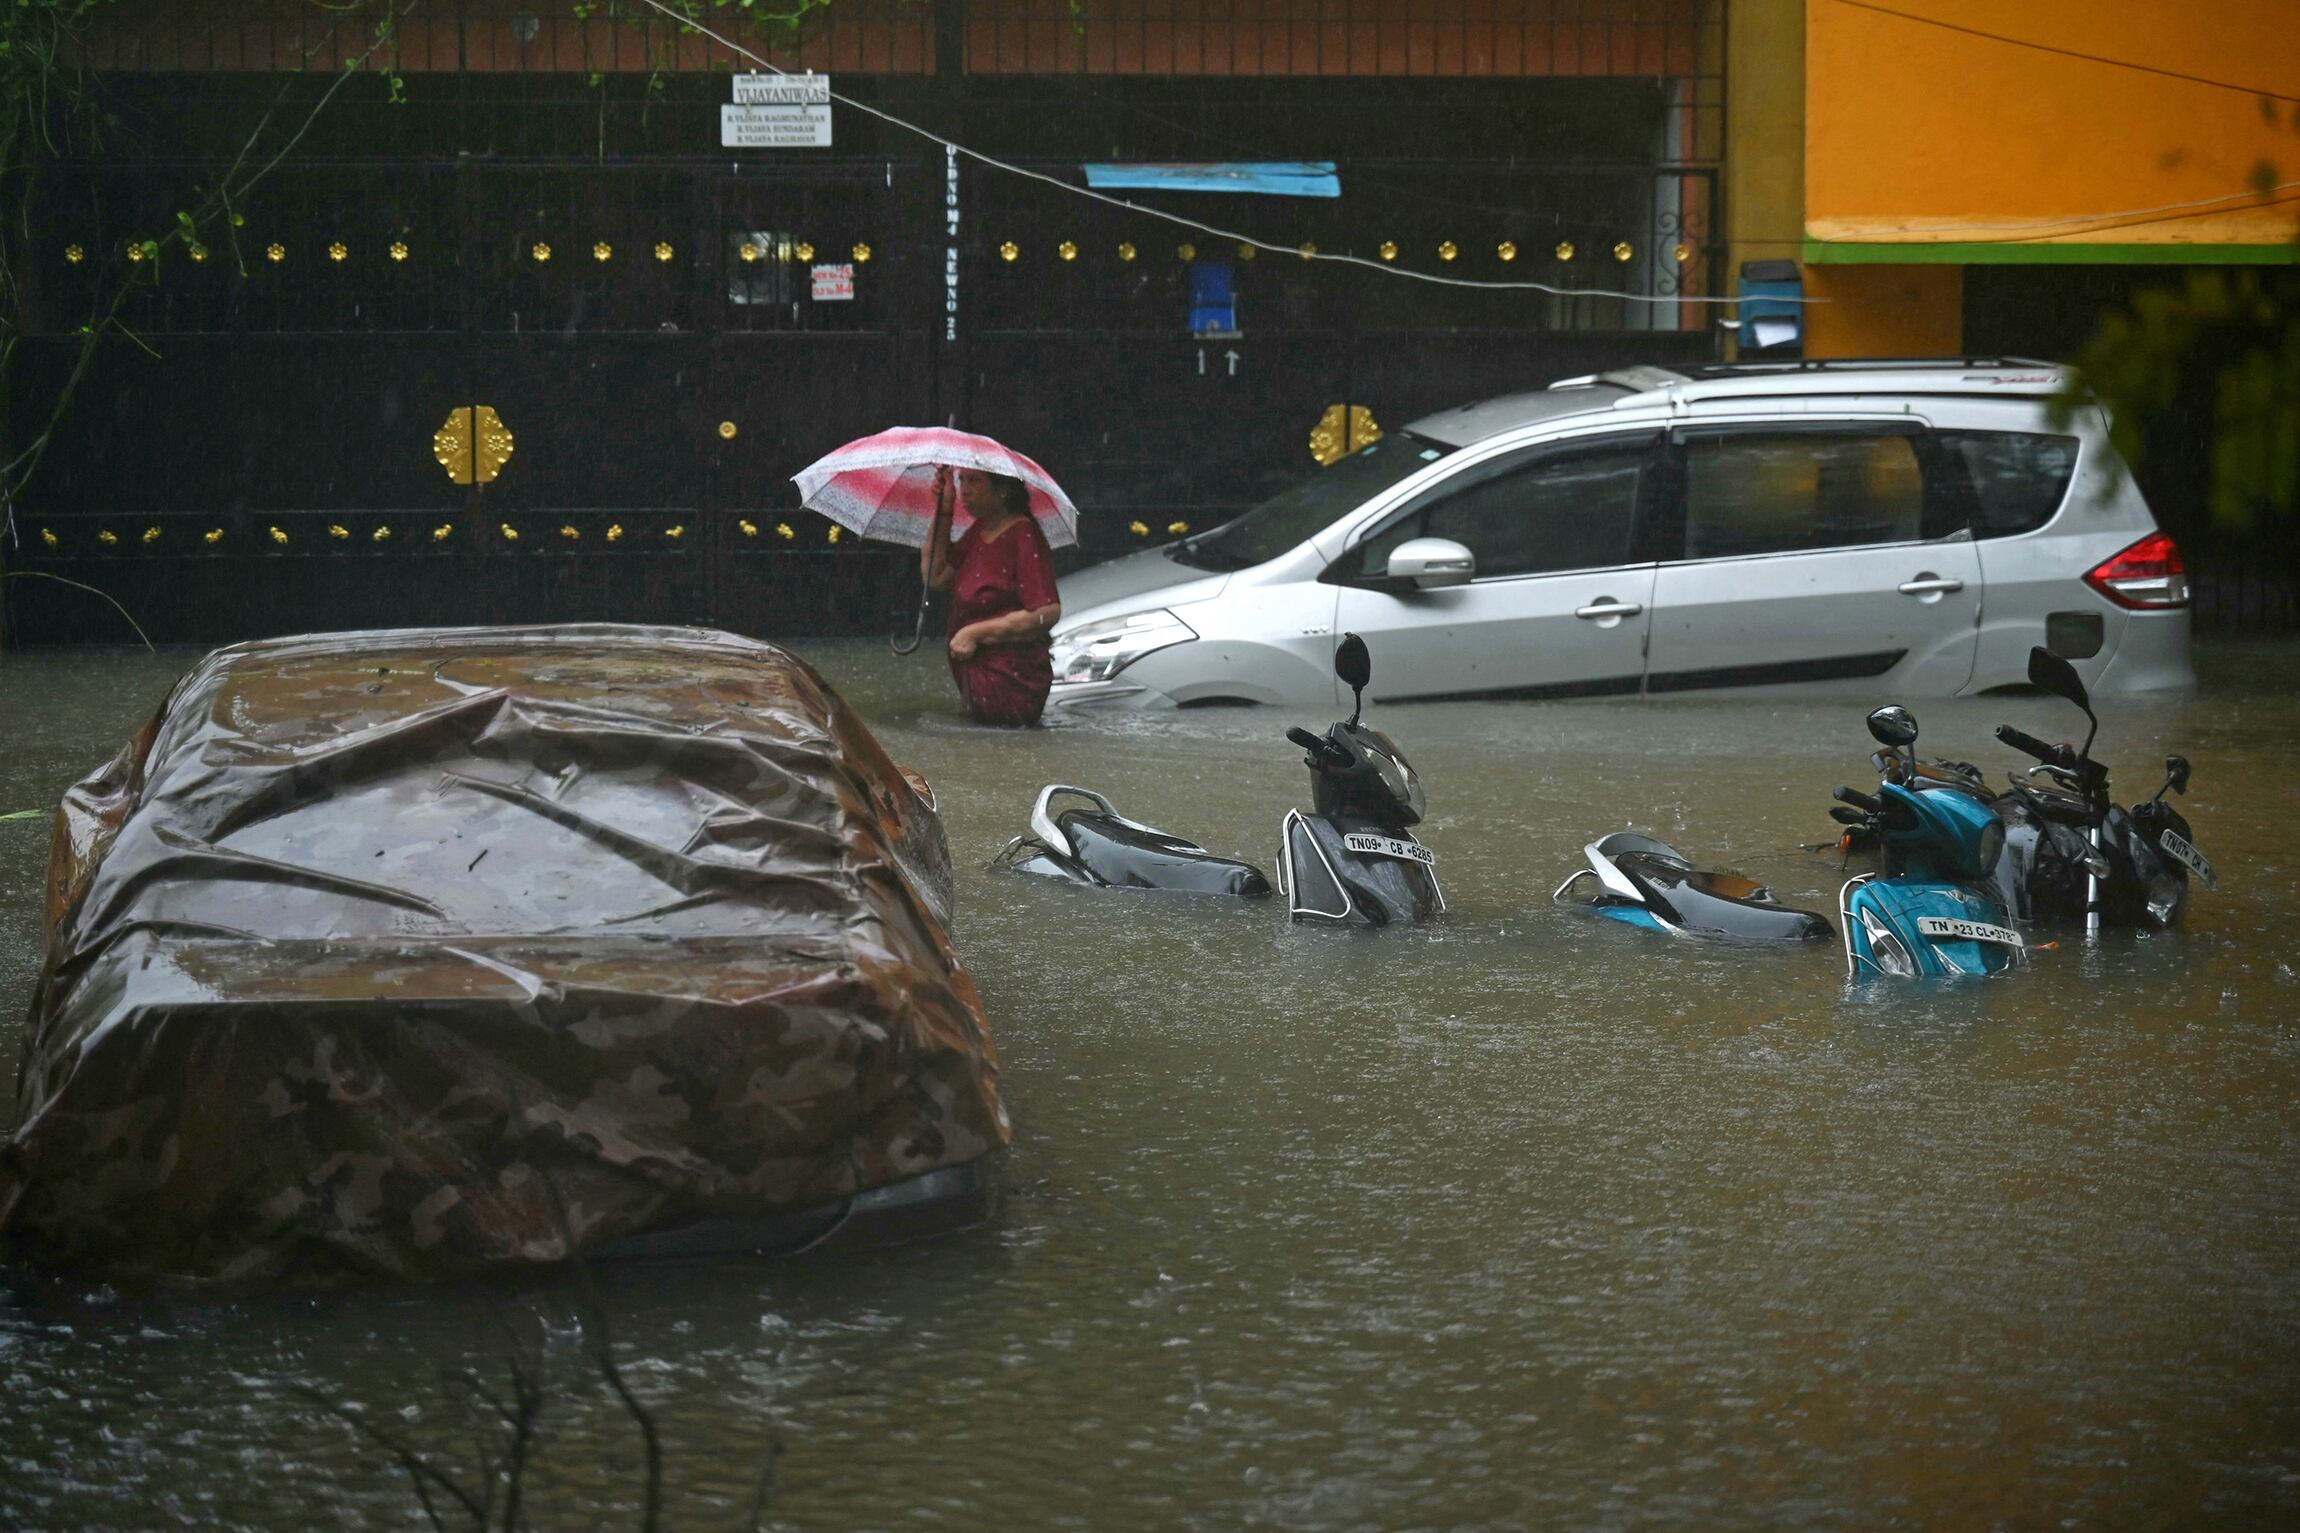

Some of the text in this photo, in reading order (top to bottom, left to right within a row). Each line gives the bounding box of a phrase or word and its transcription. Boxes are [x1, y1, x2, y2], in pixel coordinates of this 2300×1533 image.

[1349, 837, 1433, 863] TN09 CB 6285
[1929, 920, 1949, 932] TN
[1959, 923, 1973, 935] 23
[1976, 926, 1992, 938] CL
